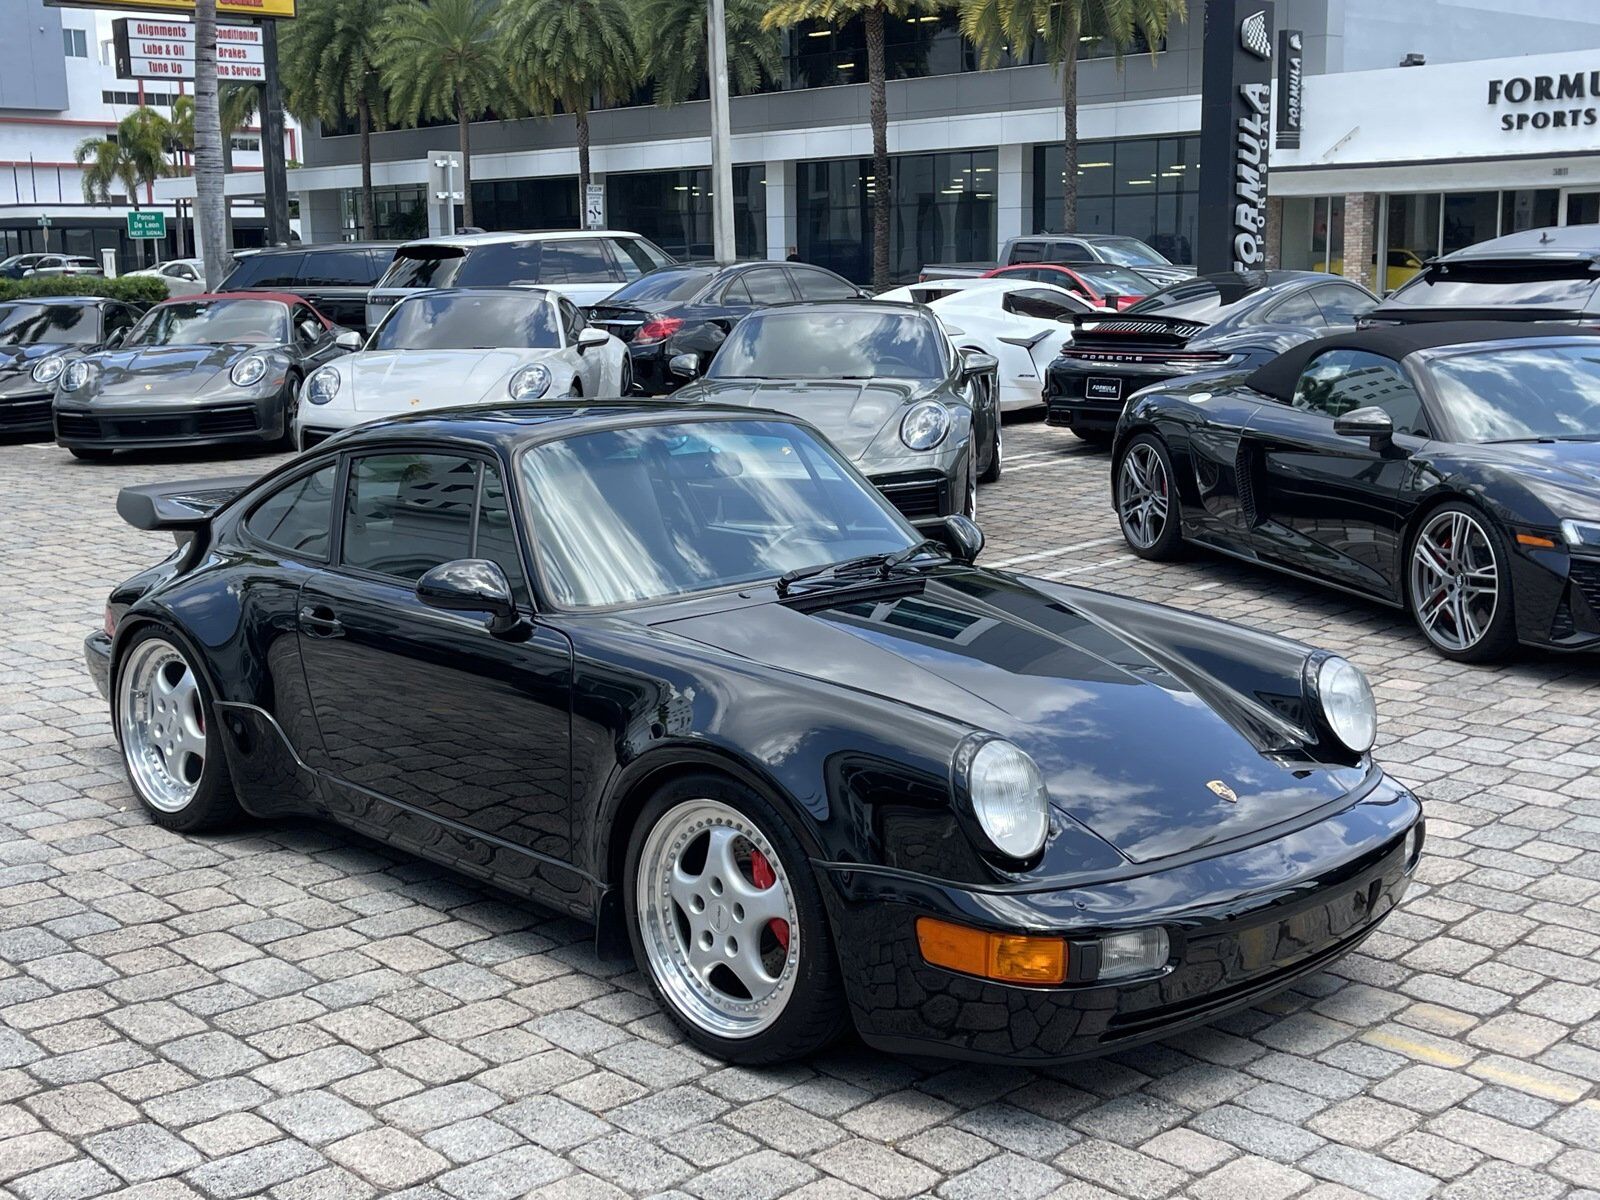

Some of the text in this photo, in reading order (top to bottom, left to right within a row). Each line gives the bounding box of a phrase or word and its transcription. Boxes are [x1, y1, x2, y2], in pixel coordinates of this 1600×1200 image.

[137, 23, 187, 38] Alignments
[142, 43, 185, 56] Lube & Oil
[218, 47, 247, 59] Brakes
[148, 61, 182, 74] Tune Up
[231, 65, 261, 77] Service
[1288, 57, 1302, 127] FORMULA
[1501, 108, 1597, 131] SPORTS
[1255, 85, 1271, 264] SPORTS CARS
